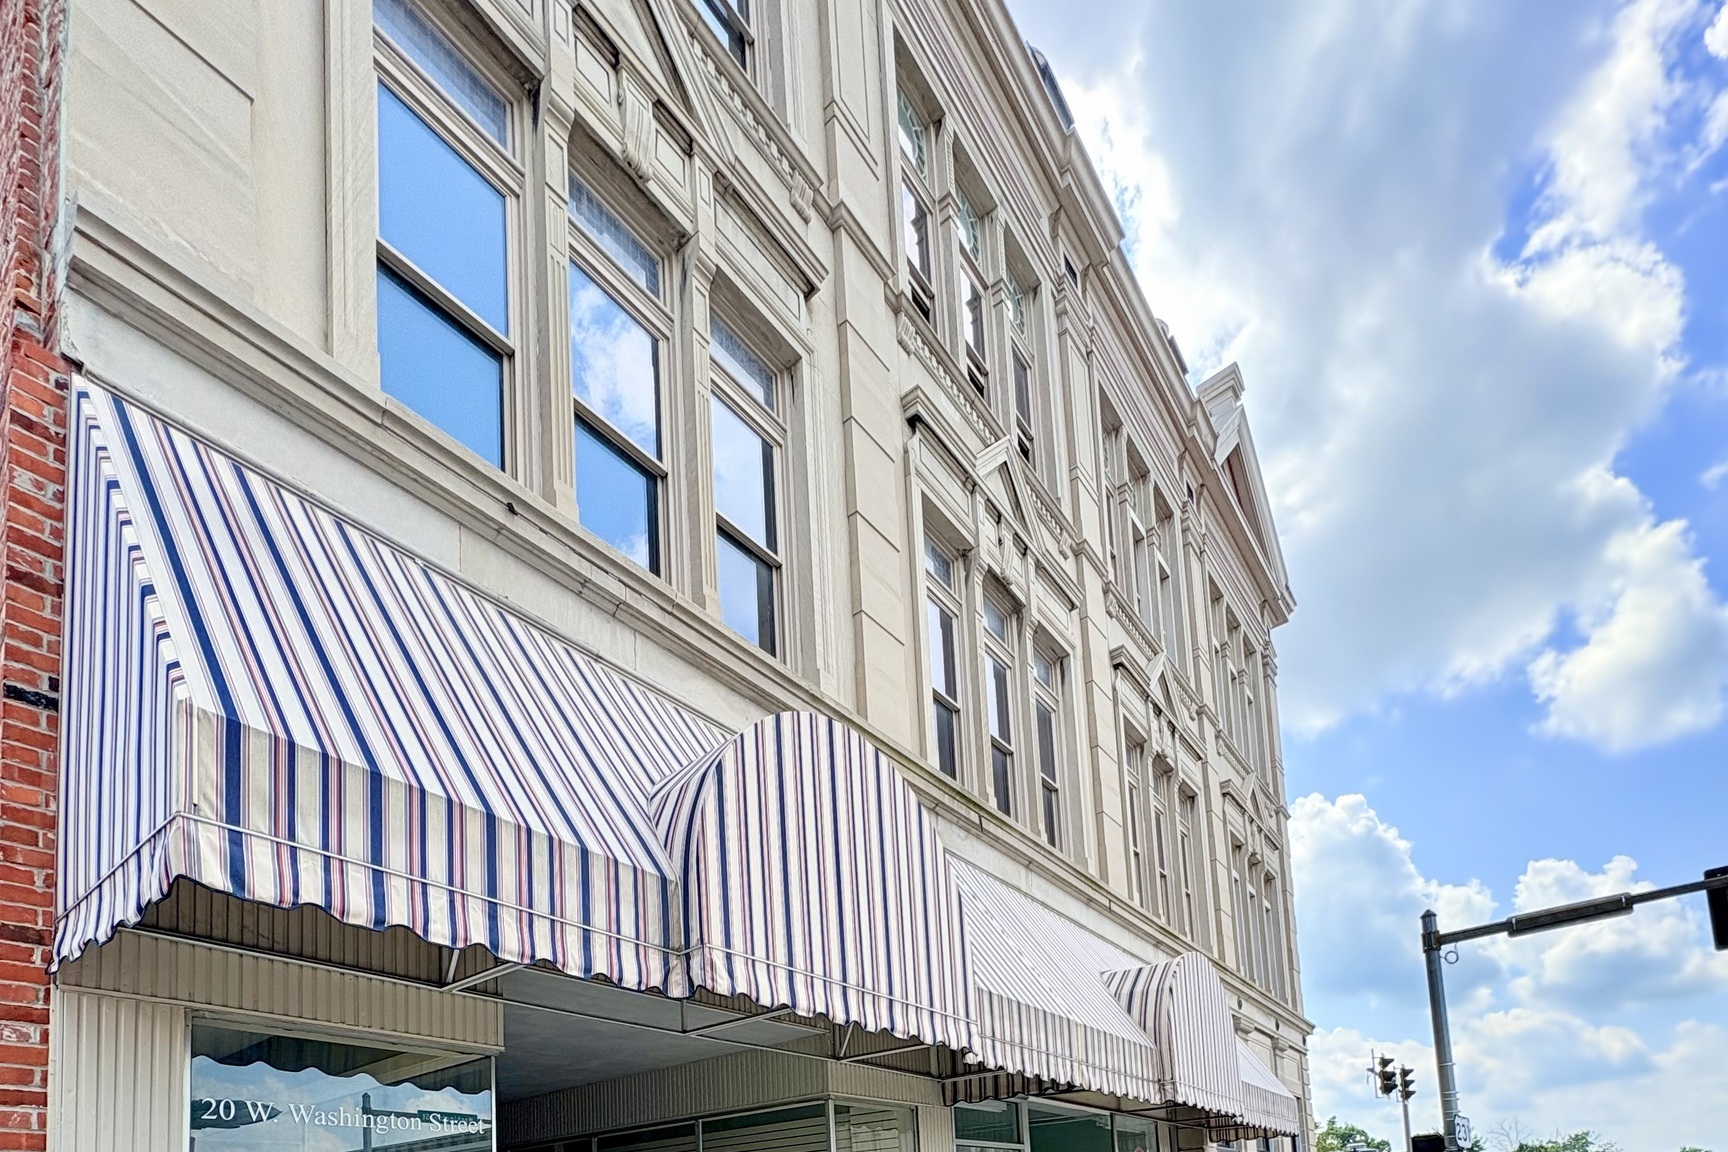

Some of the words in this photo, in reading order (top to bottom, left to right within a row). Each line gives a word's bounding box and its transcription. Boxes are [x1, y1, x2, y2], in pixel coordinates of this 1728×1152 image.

[201, 1098, 235, 1120] 20
[244, 1100, 278, 1123] W.
[288, 1103, 422, 1134] Washington
[429, 1113, 486, 1134] Street
[1456, 1122, 1471, 1143] 231
